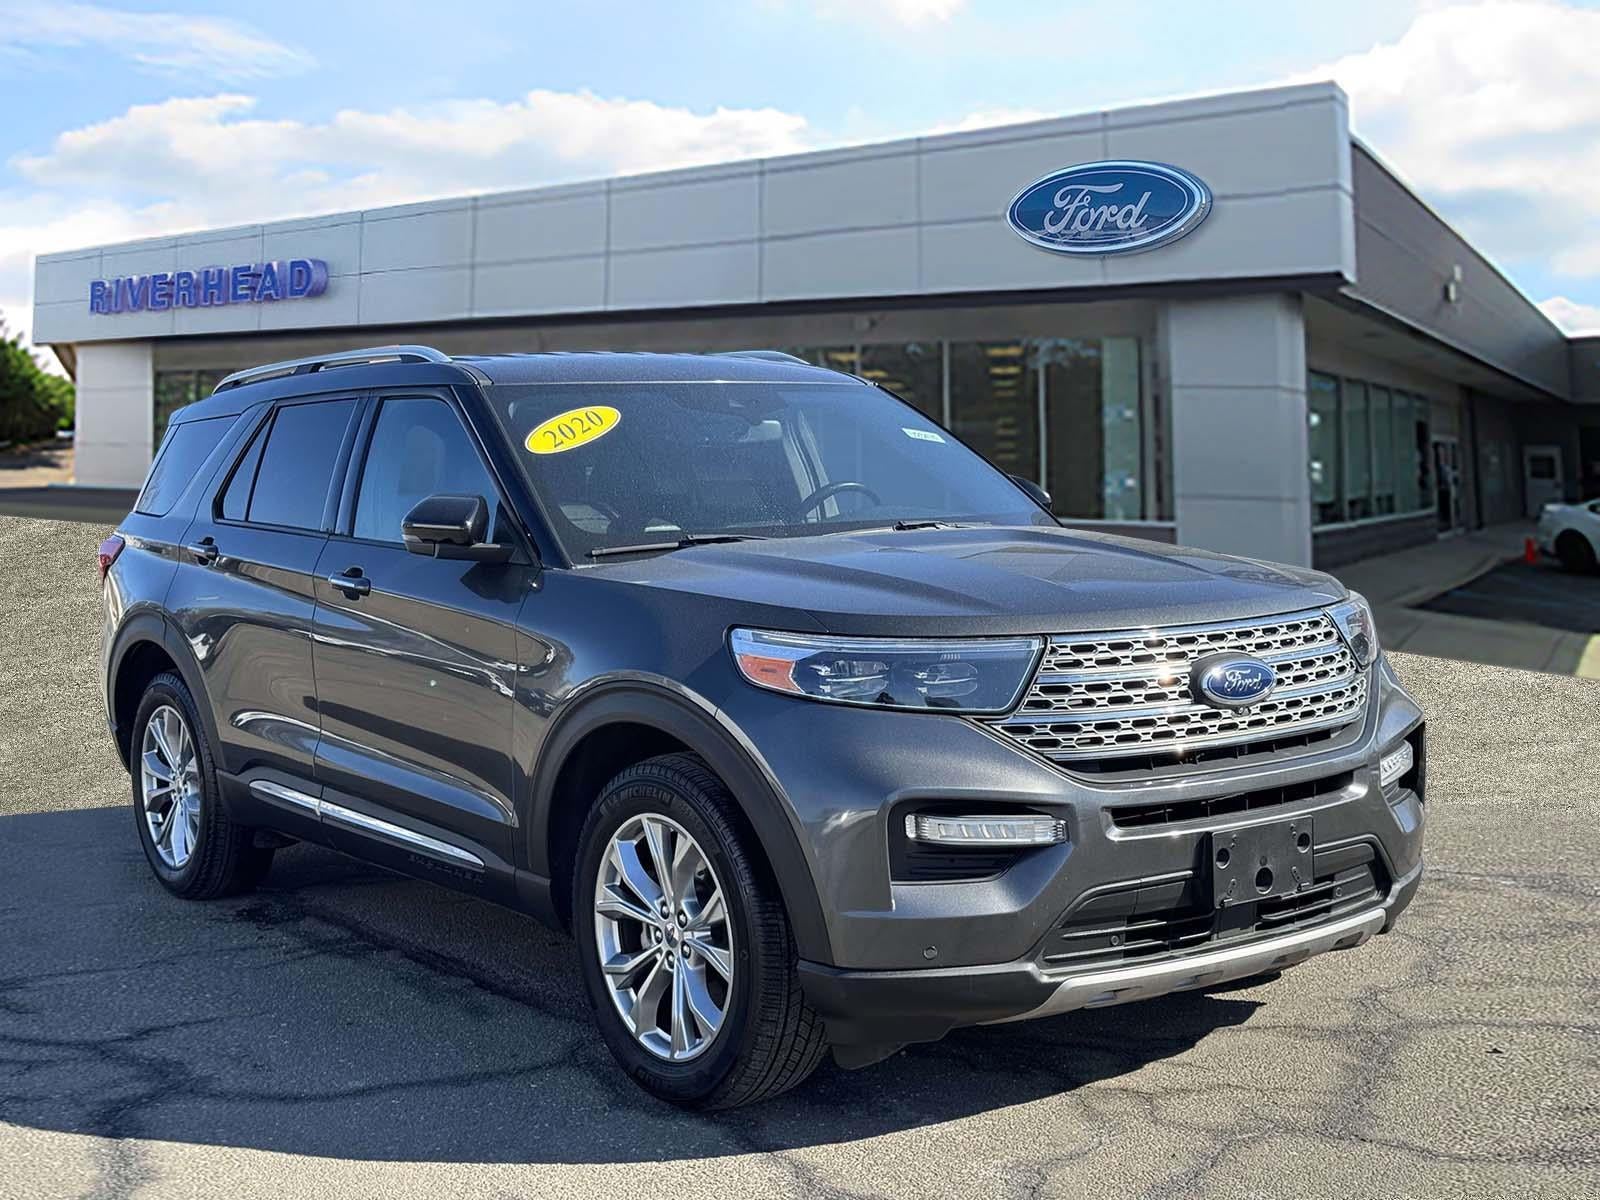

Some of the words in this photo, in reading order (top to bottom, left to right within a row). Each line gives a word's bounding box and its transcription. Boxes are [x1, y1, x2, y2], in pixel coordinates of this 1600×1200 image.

[1043, 182, 1152, 234] Ford
[89, 258, 326, 315] RIVERHEAD
[542, 410, 604, 449] 2020
[1223, 668, 1263, 692] Ford
